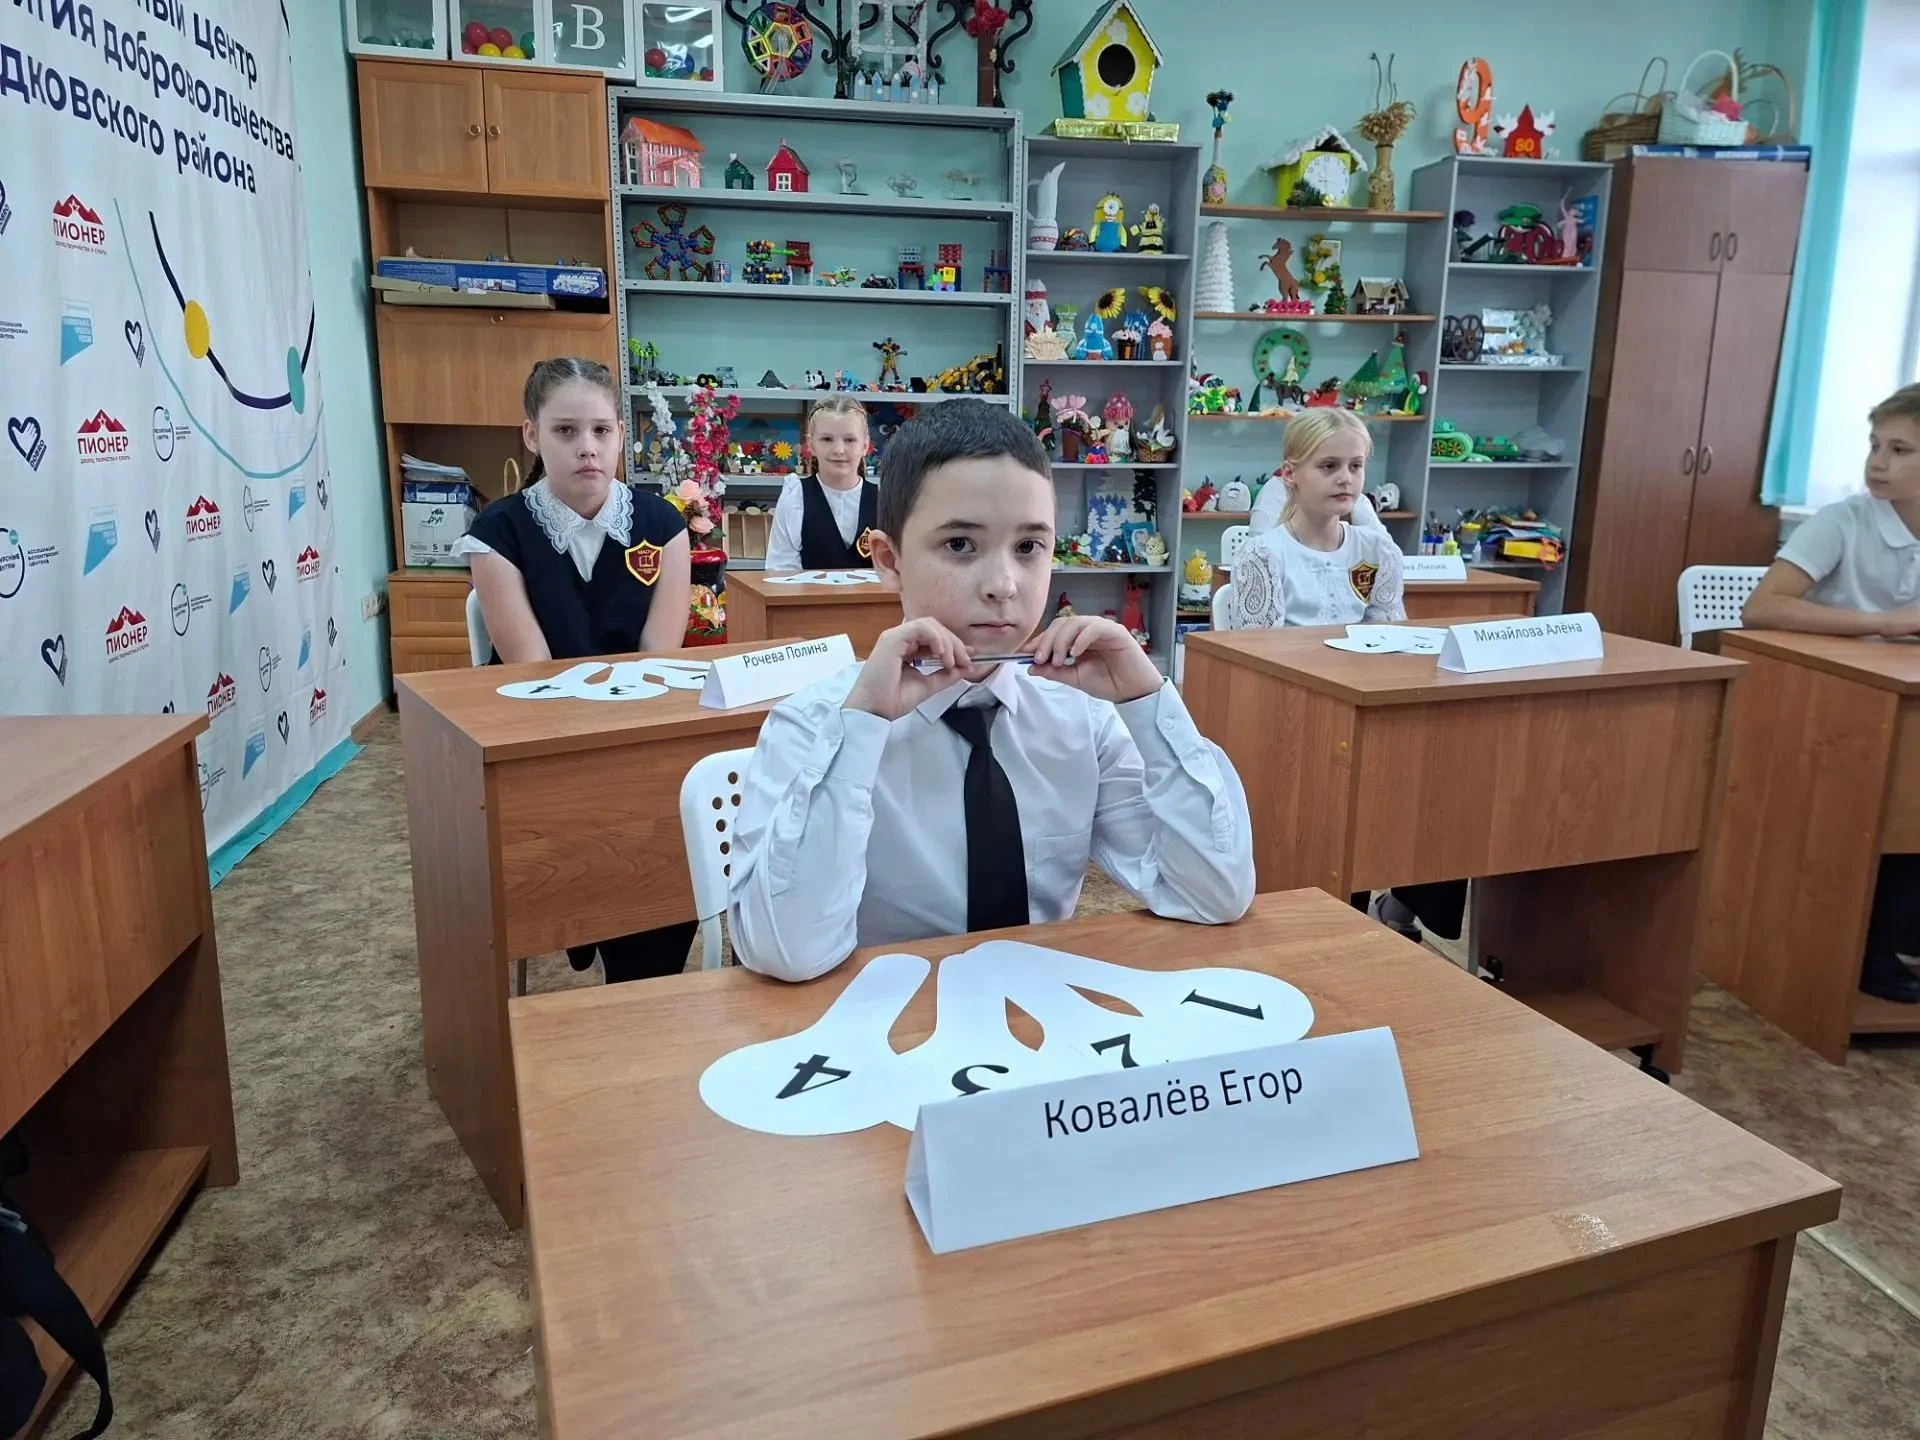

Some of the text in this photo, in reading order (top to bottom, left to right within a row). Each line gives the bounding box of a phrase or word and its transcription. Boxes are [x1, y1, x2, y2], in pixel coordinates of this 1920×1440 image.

[193, 12, 257, 90] центр
[103, 18, 294, 161] добровольчества
[0, 42, 257, 195] дковского района
[1515, 138, 1536, 153] 80
[53, 218, 106, 246] ПИОНЕР
[77, 436, 129, 455] ПИОНЕР
[186, 515, 221, 535] ПИОНЕР
[106, 625, 148, 655] ПИОНЕР
[1474, 622, 1583, 642] Михайлова Алёна
[742, 642, 828, 668] Рочева Полина
[207, 686, 236, 715] ПИОНЕР
[1180, 988, 1265, 1021] 1
[775, 1054, 852, 1100] 4
[1042, 1067, 1303, 1140] Ковалёв Егор
